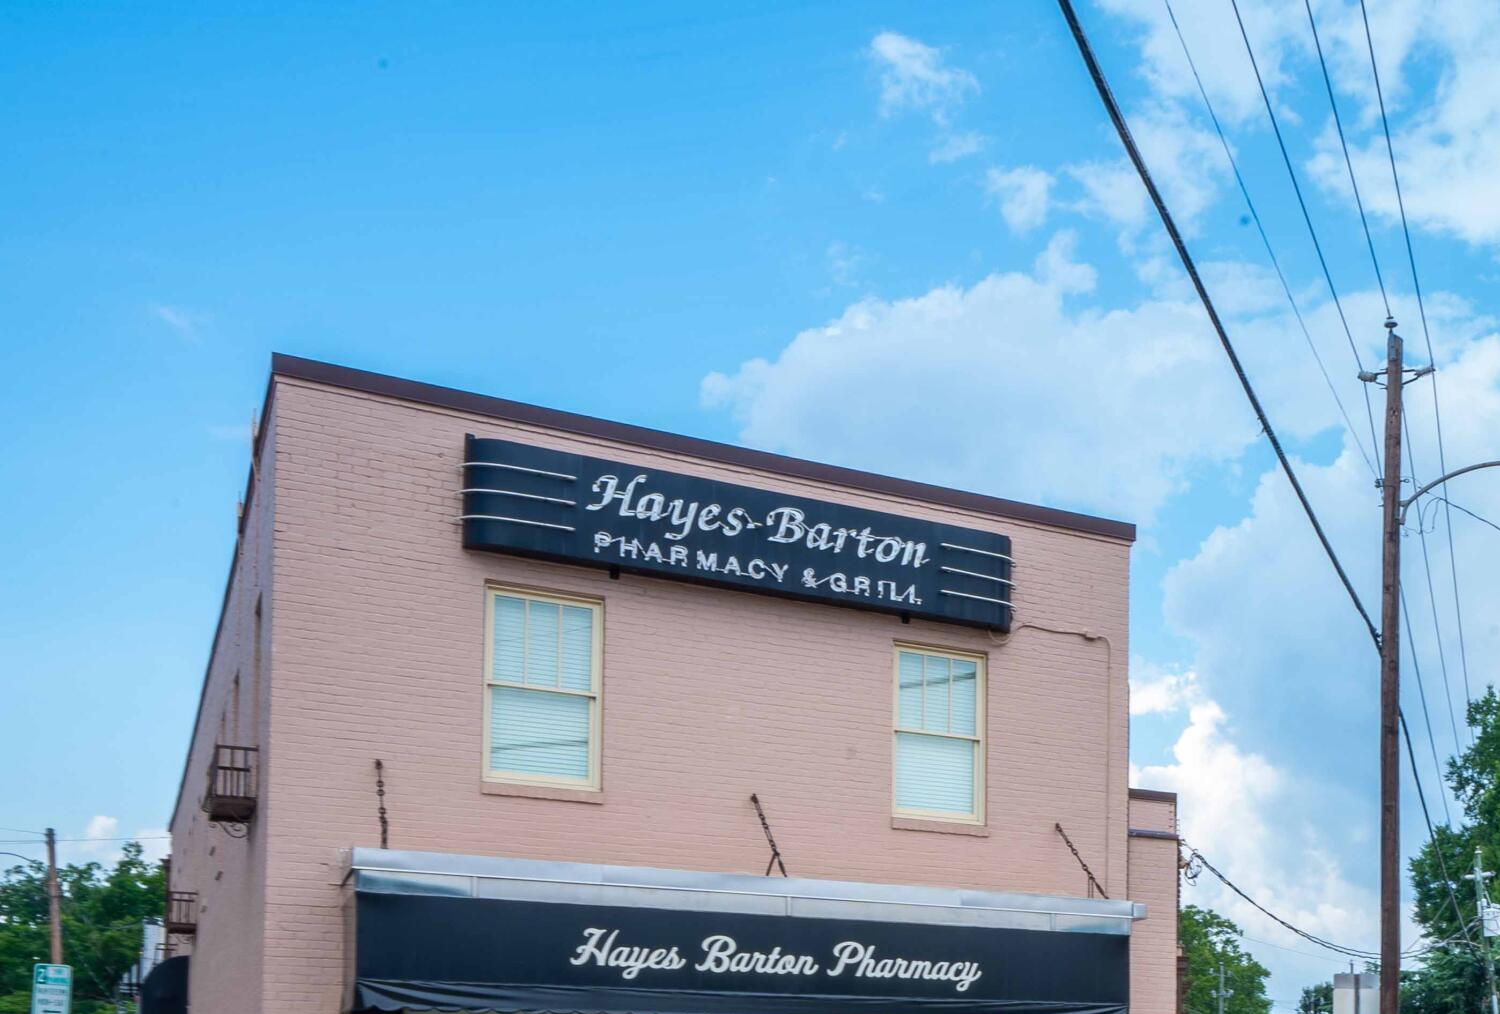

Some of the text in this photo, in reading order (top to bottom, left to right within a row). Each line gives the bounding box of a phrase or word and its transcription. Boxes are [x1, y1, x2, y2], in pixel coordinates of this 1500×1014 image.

[593, 531, 923, 605] PHARMACY & GRILL
[37, 968, 47, 982] 2
[570, 927, 982, 992] Hayes Barton Pharmacy
